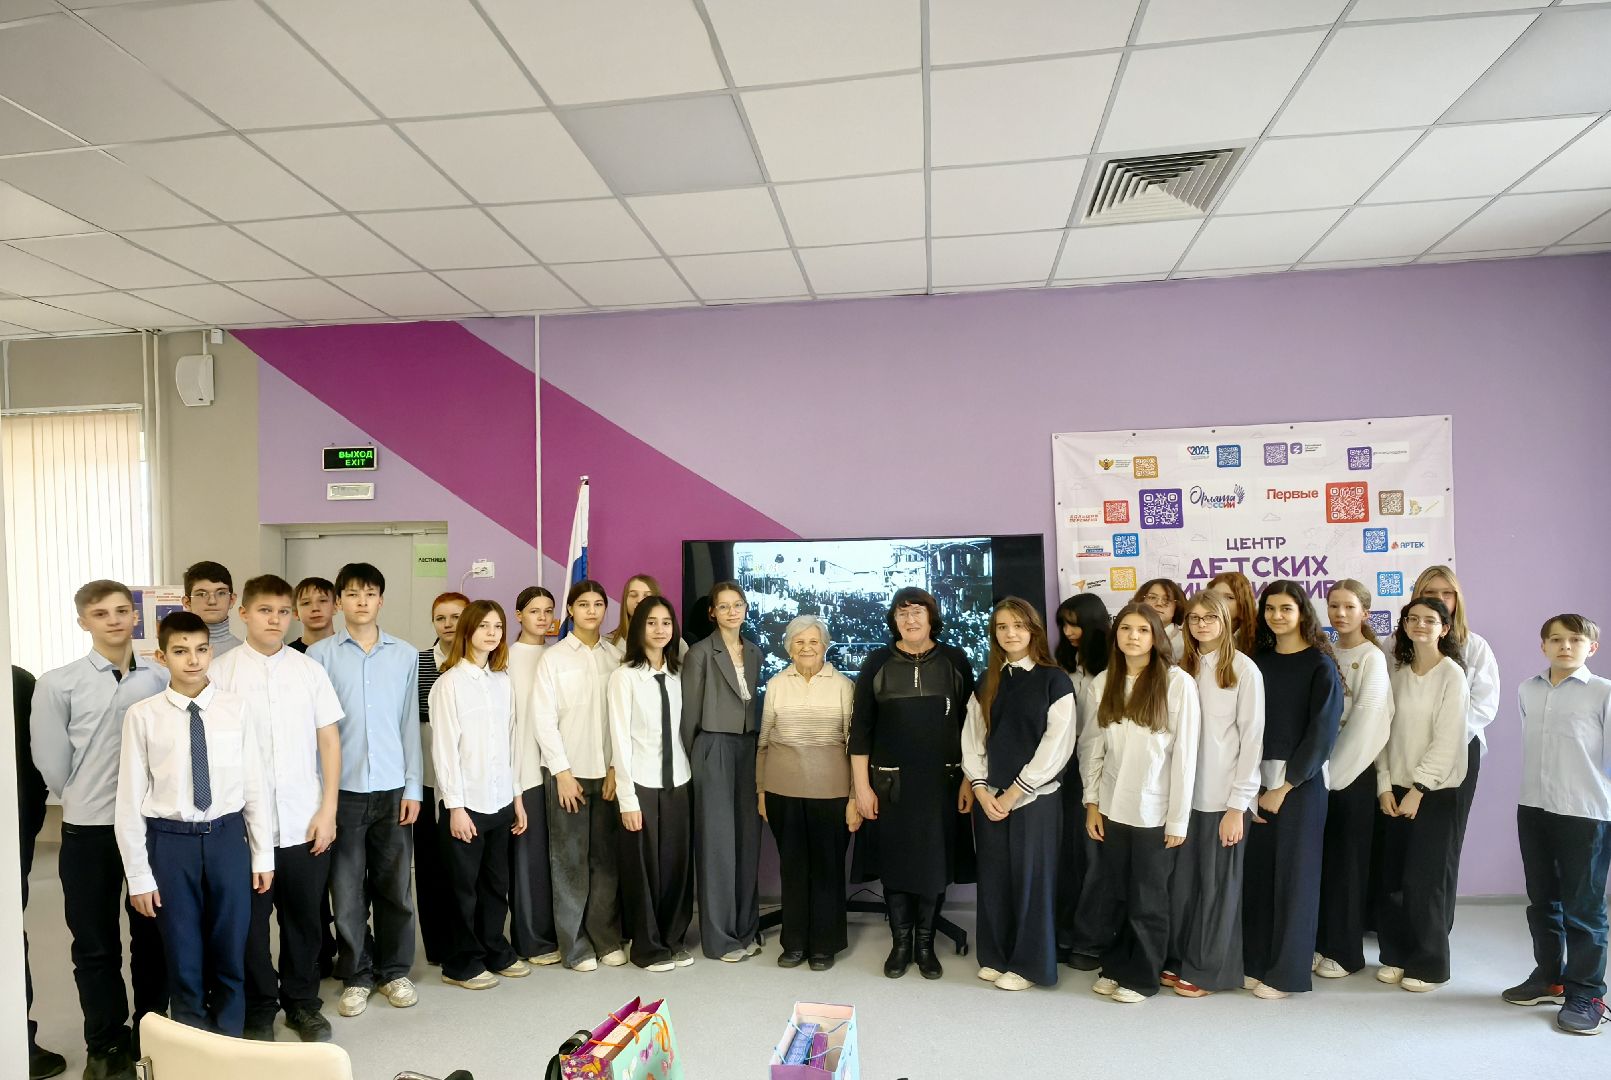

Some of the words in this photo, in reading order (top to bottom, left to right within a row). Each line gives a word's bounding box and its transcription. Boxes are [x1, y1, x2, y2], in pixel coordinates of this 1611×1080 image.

[338, 450, 373, 458] ВЫХОД
[1191, 445, 1210, 455] 2024
[1266, 488, 1319, 502] Первые
[1226, 536, 1286, 551] ЦЕНТР
[1400, 541, 1425, 549] АРТЕК
[1187, 555, 1329, 579] ДЕТСКИХ
